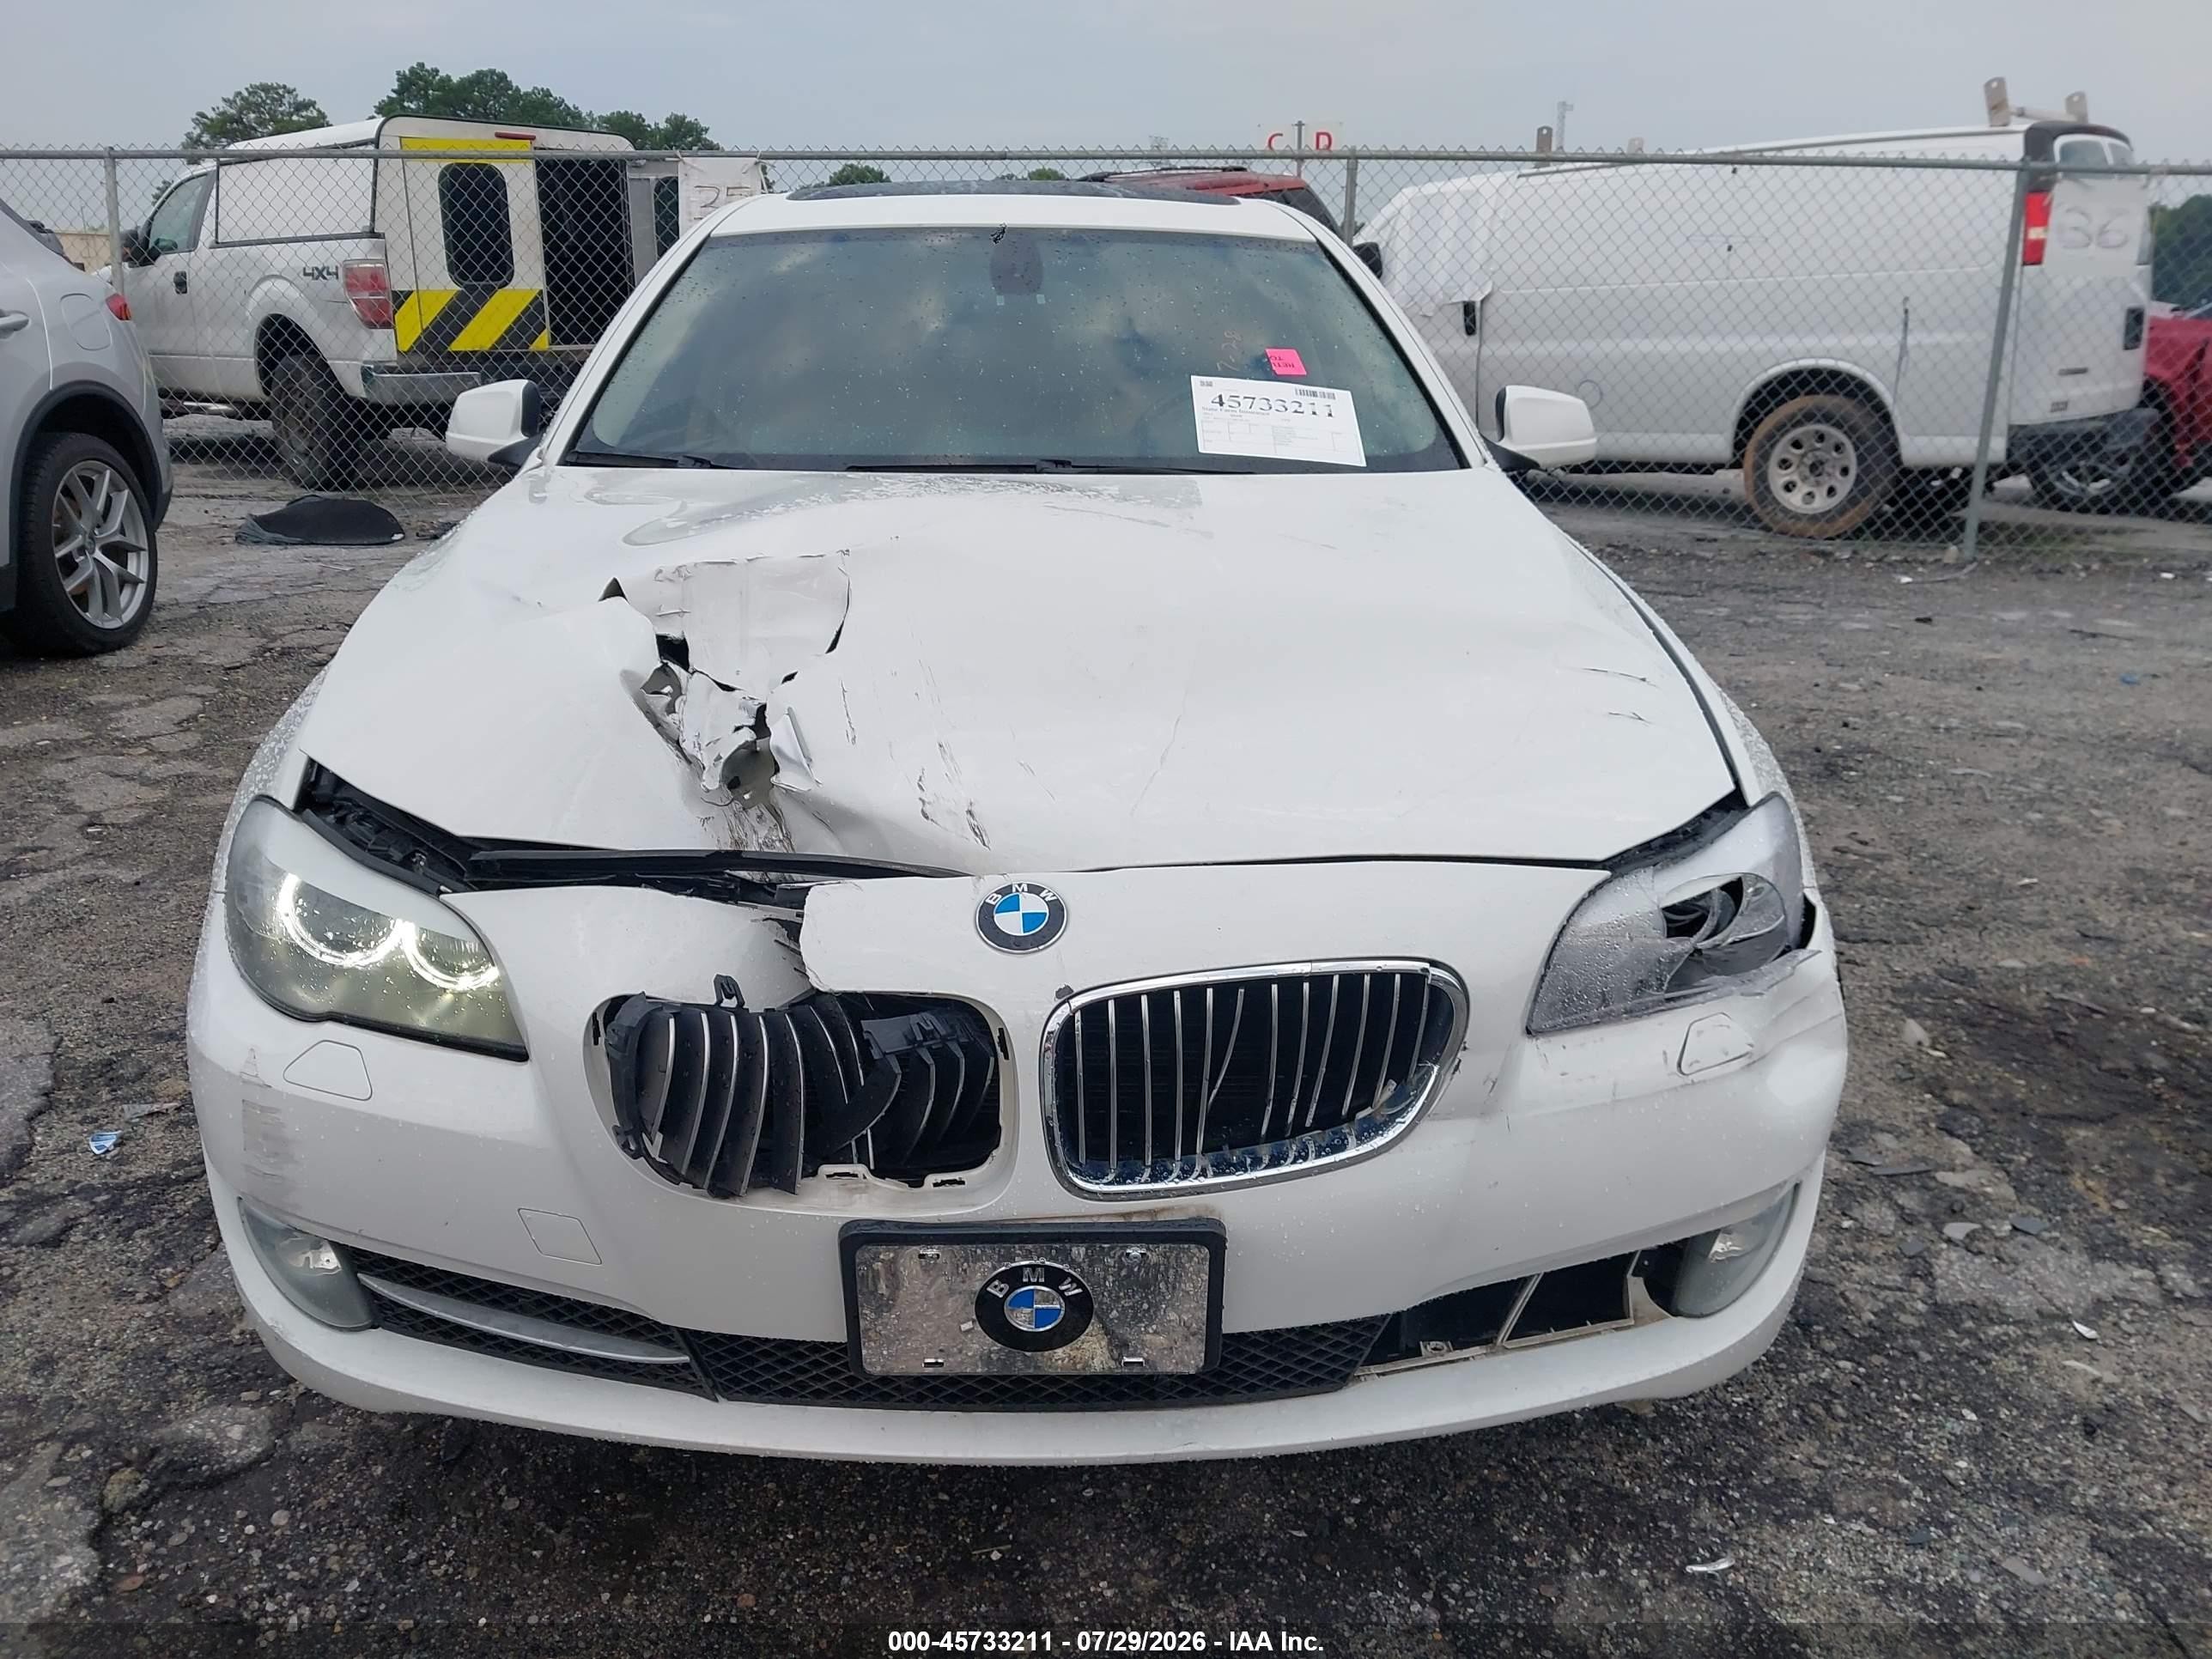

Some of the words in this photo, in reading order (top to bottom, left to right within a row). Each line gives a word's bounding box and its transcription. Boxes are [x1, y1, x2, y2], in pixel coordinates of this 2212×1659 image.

[1211, 393, 1334, 417] 45733211
[985, 884, 1058, 905] BMW
[987, 1267, 1084, 1298] BMW
